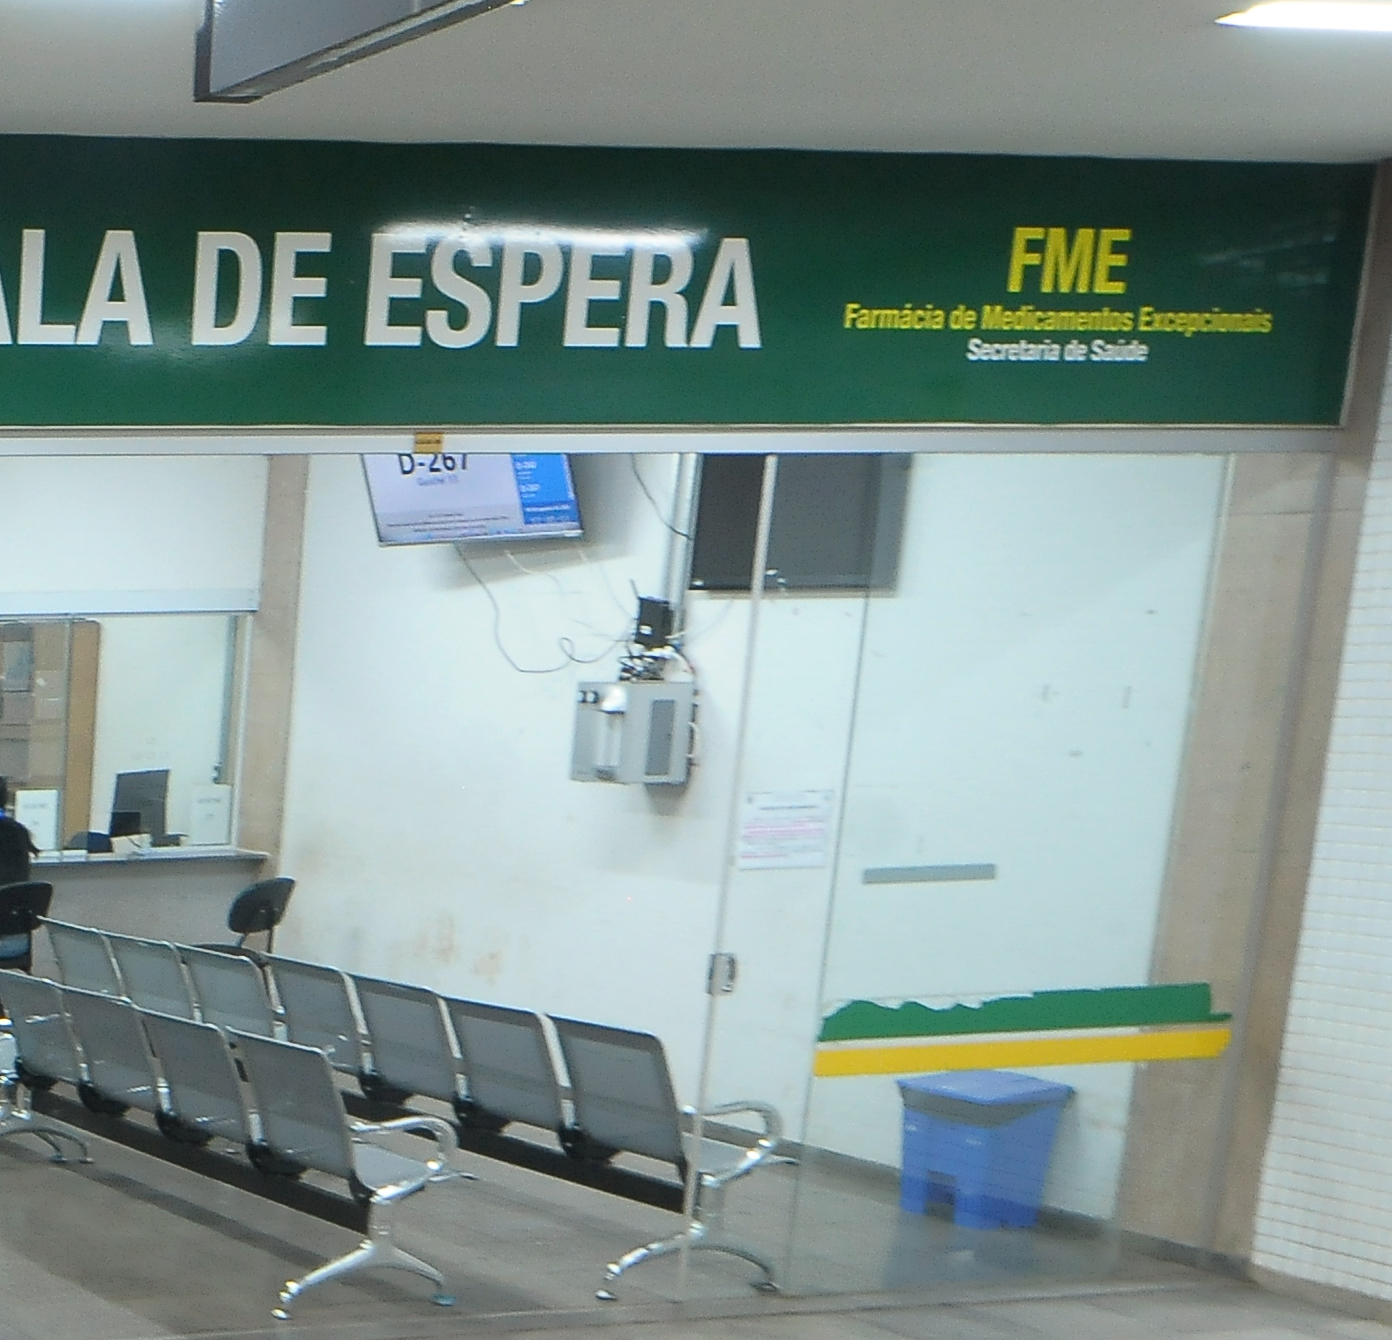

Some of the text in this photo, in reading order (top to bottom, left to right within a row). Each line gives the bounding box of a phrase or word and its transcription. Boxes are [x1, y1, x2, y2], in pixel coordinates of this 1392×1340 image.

[1007, 227, 1131, 294] FME
[191, 231, 332, 347] DE
[364, 231, 762, 350] ESPERA
[843, 303, 1274, 337] Farmácia de Medicamentos Excepcionais
[966, 338, 1149, 362] Secretaria de Saúde
